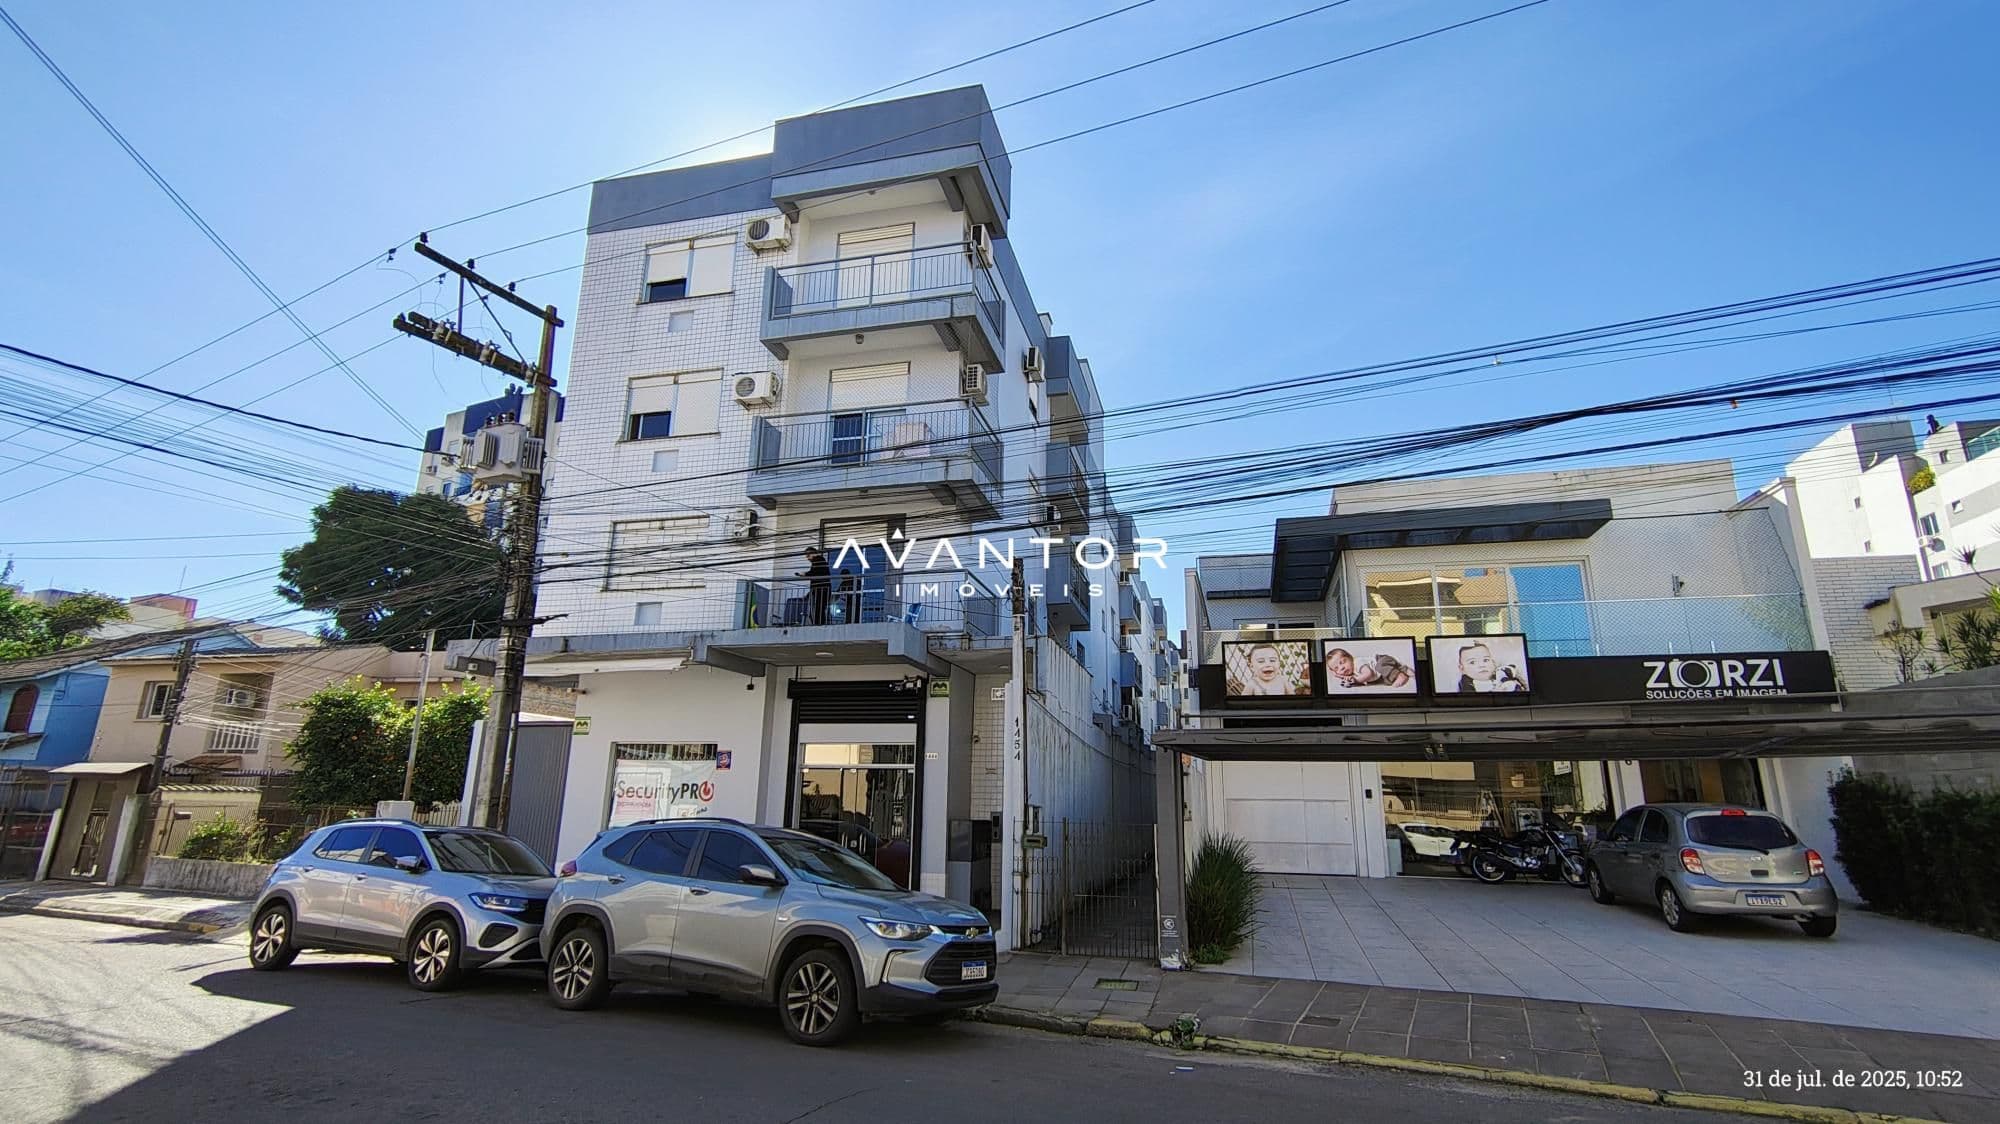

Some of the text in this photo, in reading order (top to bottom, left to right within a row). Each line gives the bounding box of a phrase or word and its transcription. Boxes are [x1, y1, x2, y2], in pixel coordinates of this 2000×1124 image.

[1643, 658, 1785, 688] ZORZI
[1715, 689, 1733, 697] EM
[1737, 688, 1788, 696] IMAGEM
